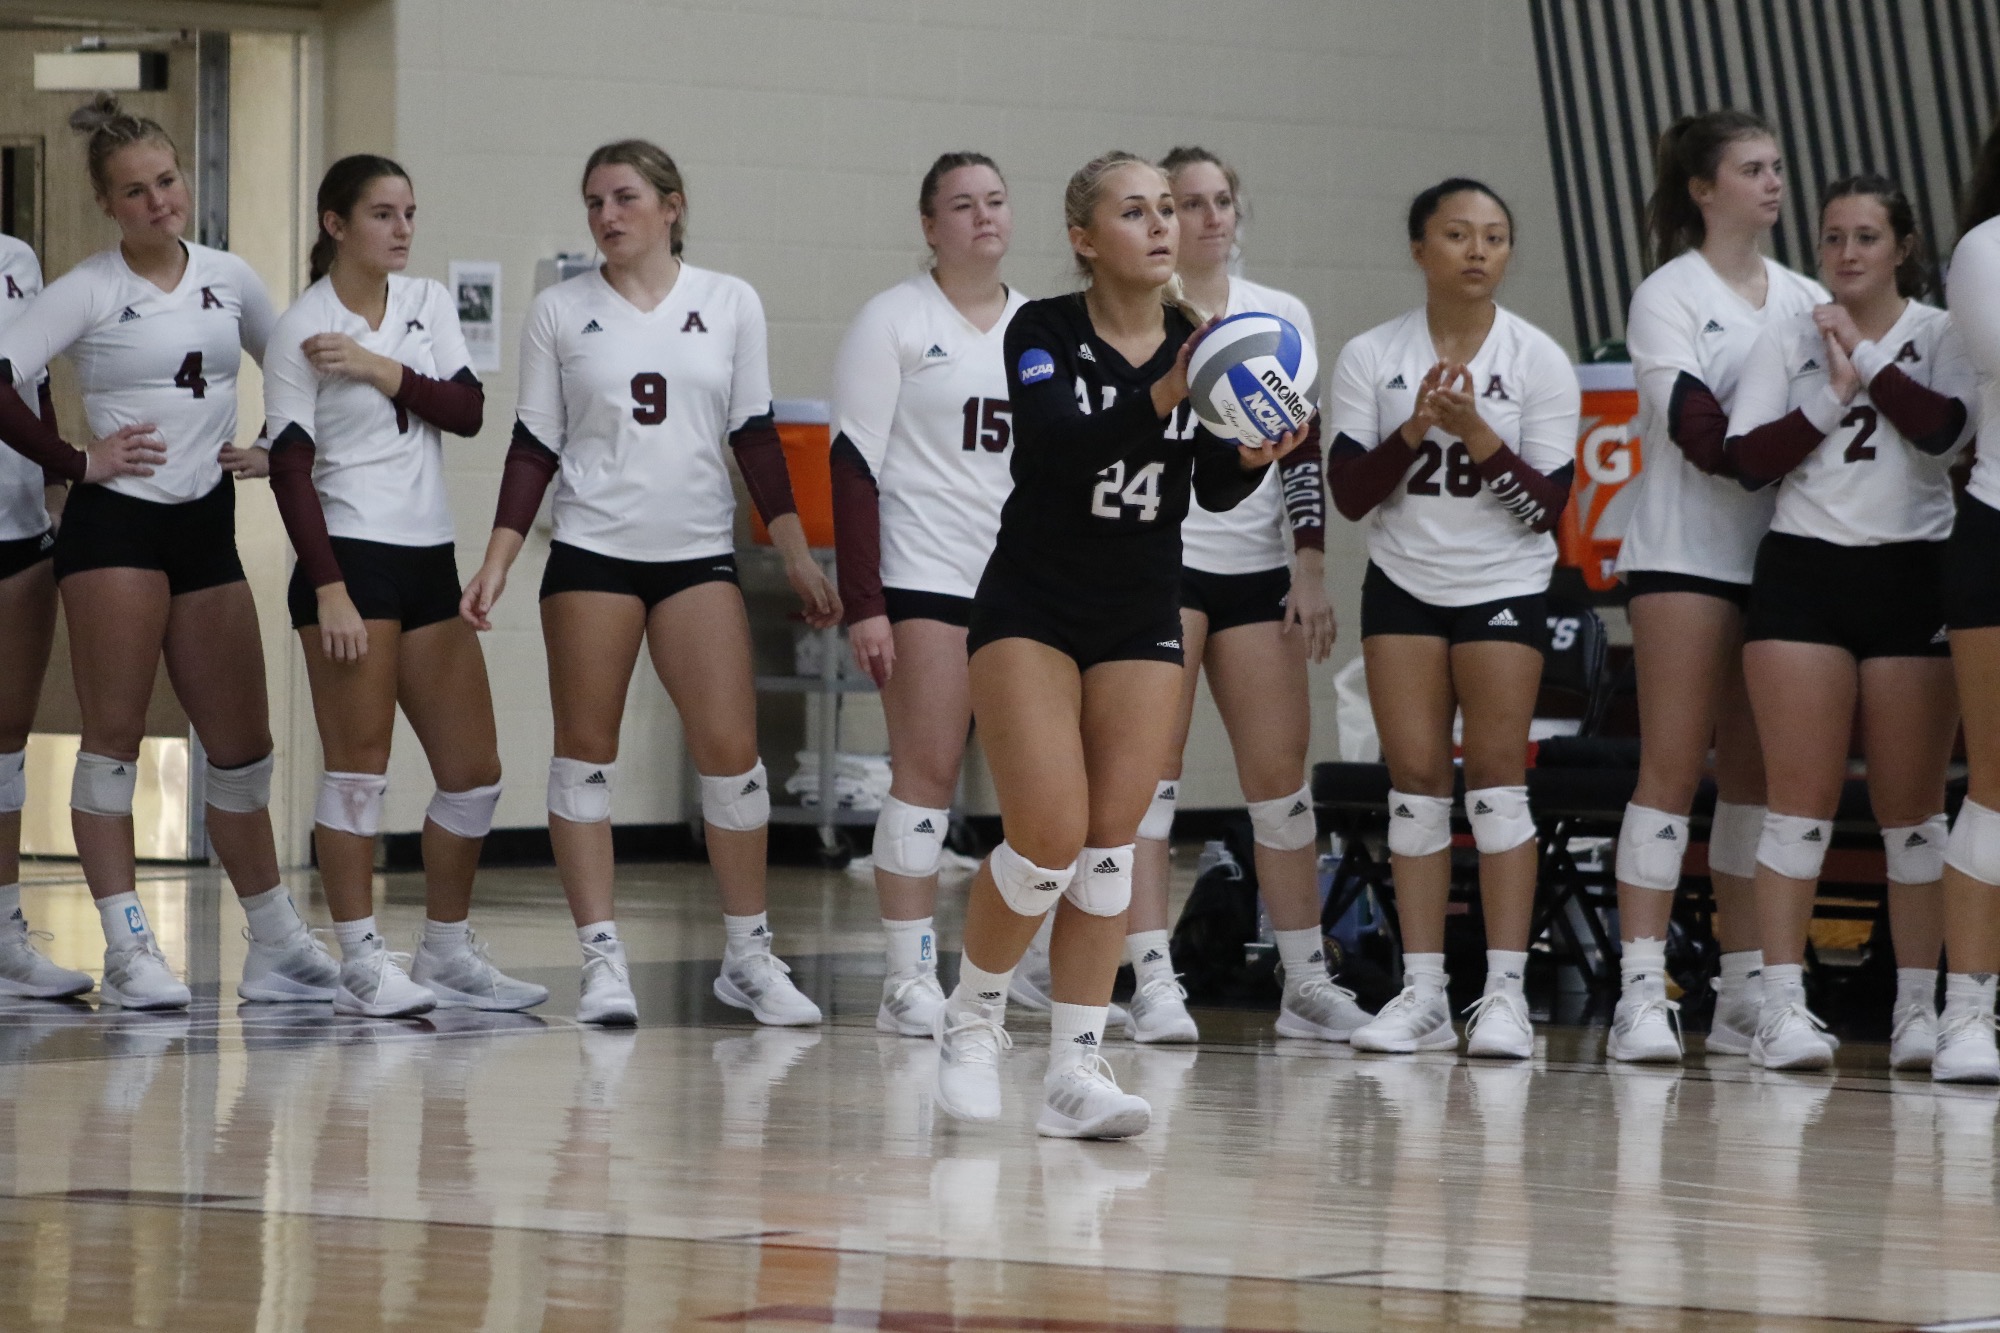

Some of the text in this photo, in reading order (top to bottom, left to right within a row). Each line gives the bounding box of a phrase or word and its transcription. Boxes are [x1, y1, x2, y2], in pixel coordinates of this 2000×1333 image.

[6, 274, 24, 299] A
[201, 286, 224, 309] A
[680, 310, 708, 333] A
[175, 351, 207, 399] 4
[1021, 363, 1055, 381] NCAA
[1894, 339, 1922, 363] A
[630, 372, 667, 425] 9
[1261, 369, 1306, 425] molten
[1481, 374, 1509, 400] A
[962, 397, 1012, 453] 15
[1240, 390, 1289, 436] NCAA
[1840, 406, 1877, 464] 2
[1407, 440, 1482, 498] 28
[1583, 424, 1631, 485] G
[1091, 459, 1165, 522] 24
